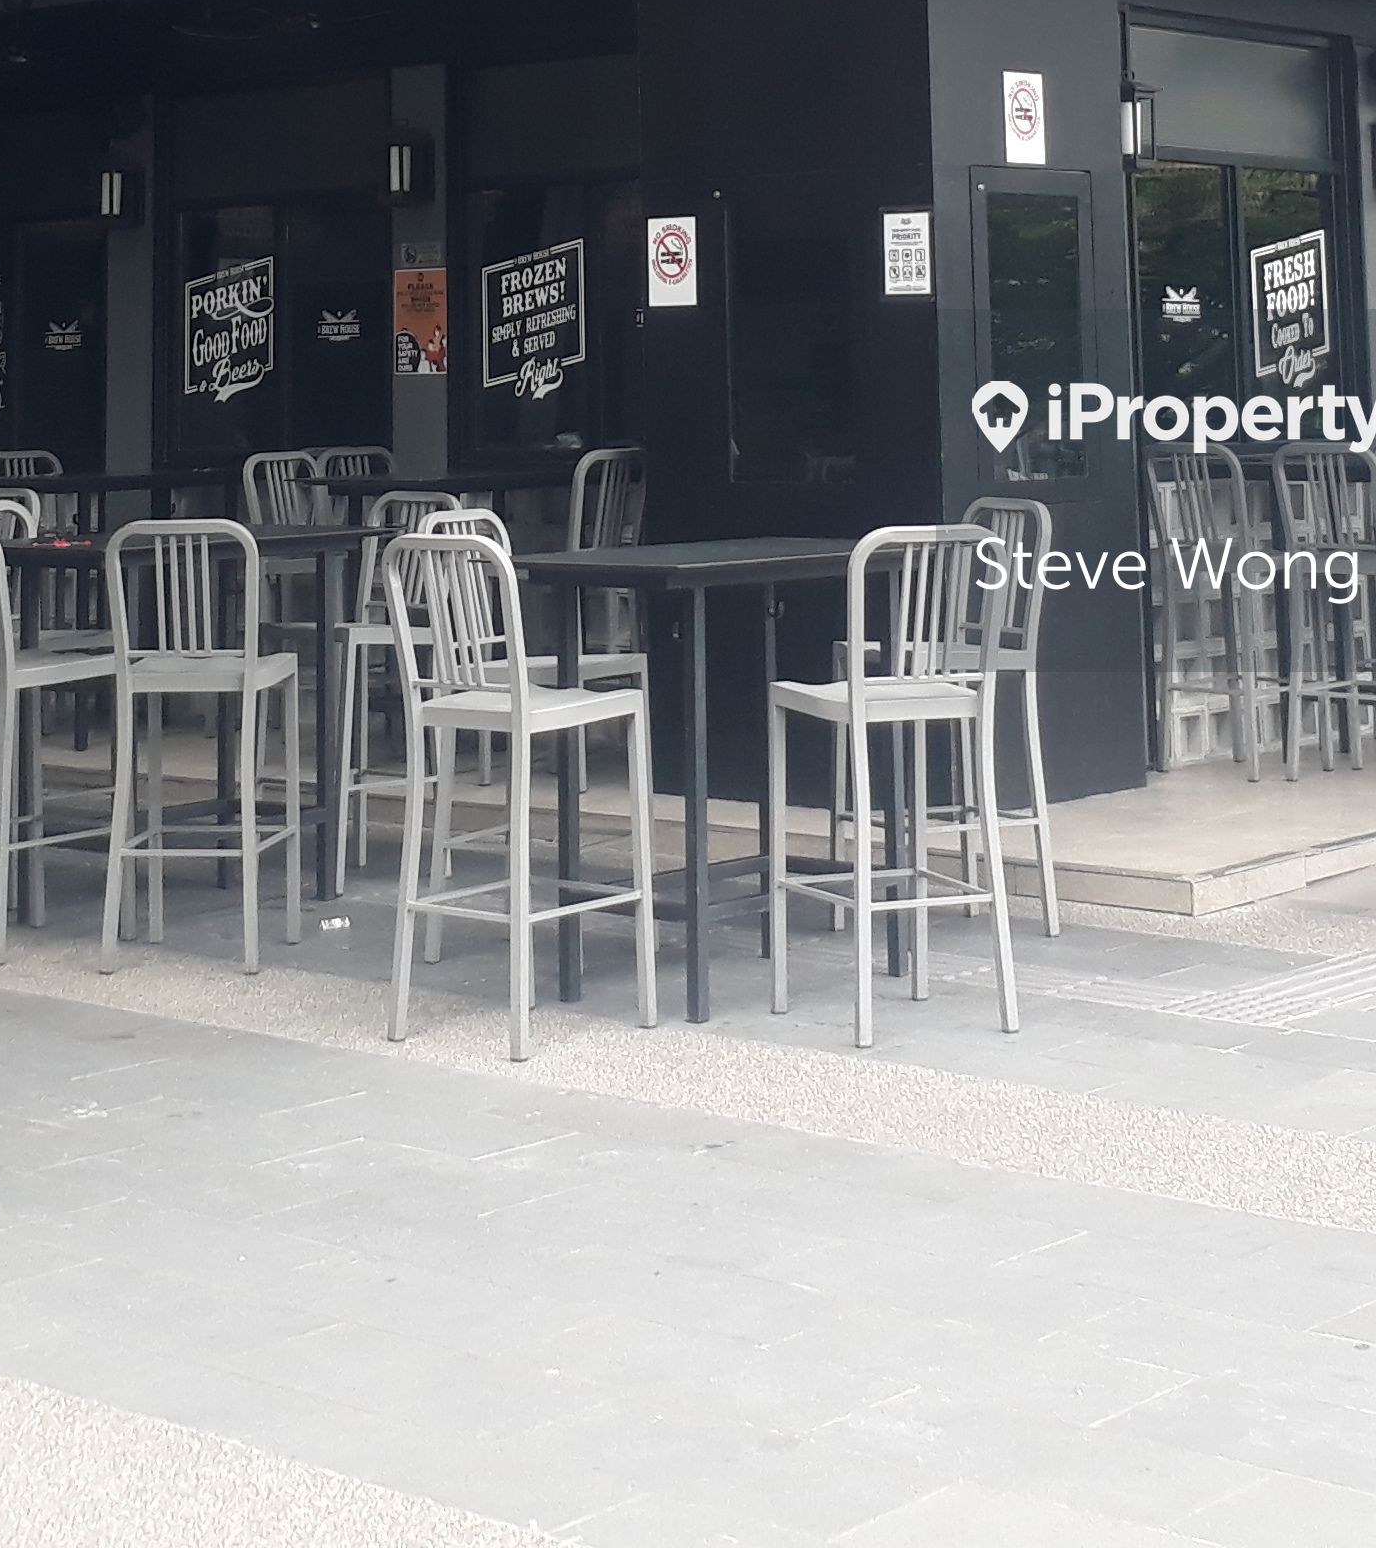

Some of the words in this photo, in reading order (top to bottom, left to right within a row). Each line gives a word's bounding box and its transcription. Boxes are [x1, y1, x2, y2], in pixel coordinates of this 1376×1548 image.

[501, 257, 566, 295] FROZEN
[1263, 249, 1316, 291] FRESH
[191, 275, 274, 320] PORKIN'
[502, 280, 566, 318] BREWS!
[1265, 279, 1315, 321] FOOD!
[192, 329, 230, 366] GOOD
[230, 315, 267, 354] FOOD
[492, 320, 522, 343] SIMPLY
[526, 304, 576, 333] REFRESHING
[524, 331, 555, 354] SERVED
[209, 355, 265, 402] Beers
[515, 356, 563, 400] Right
